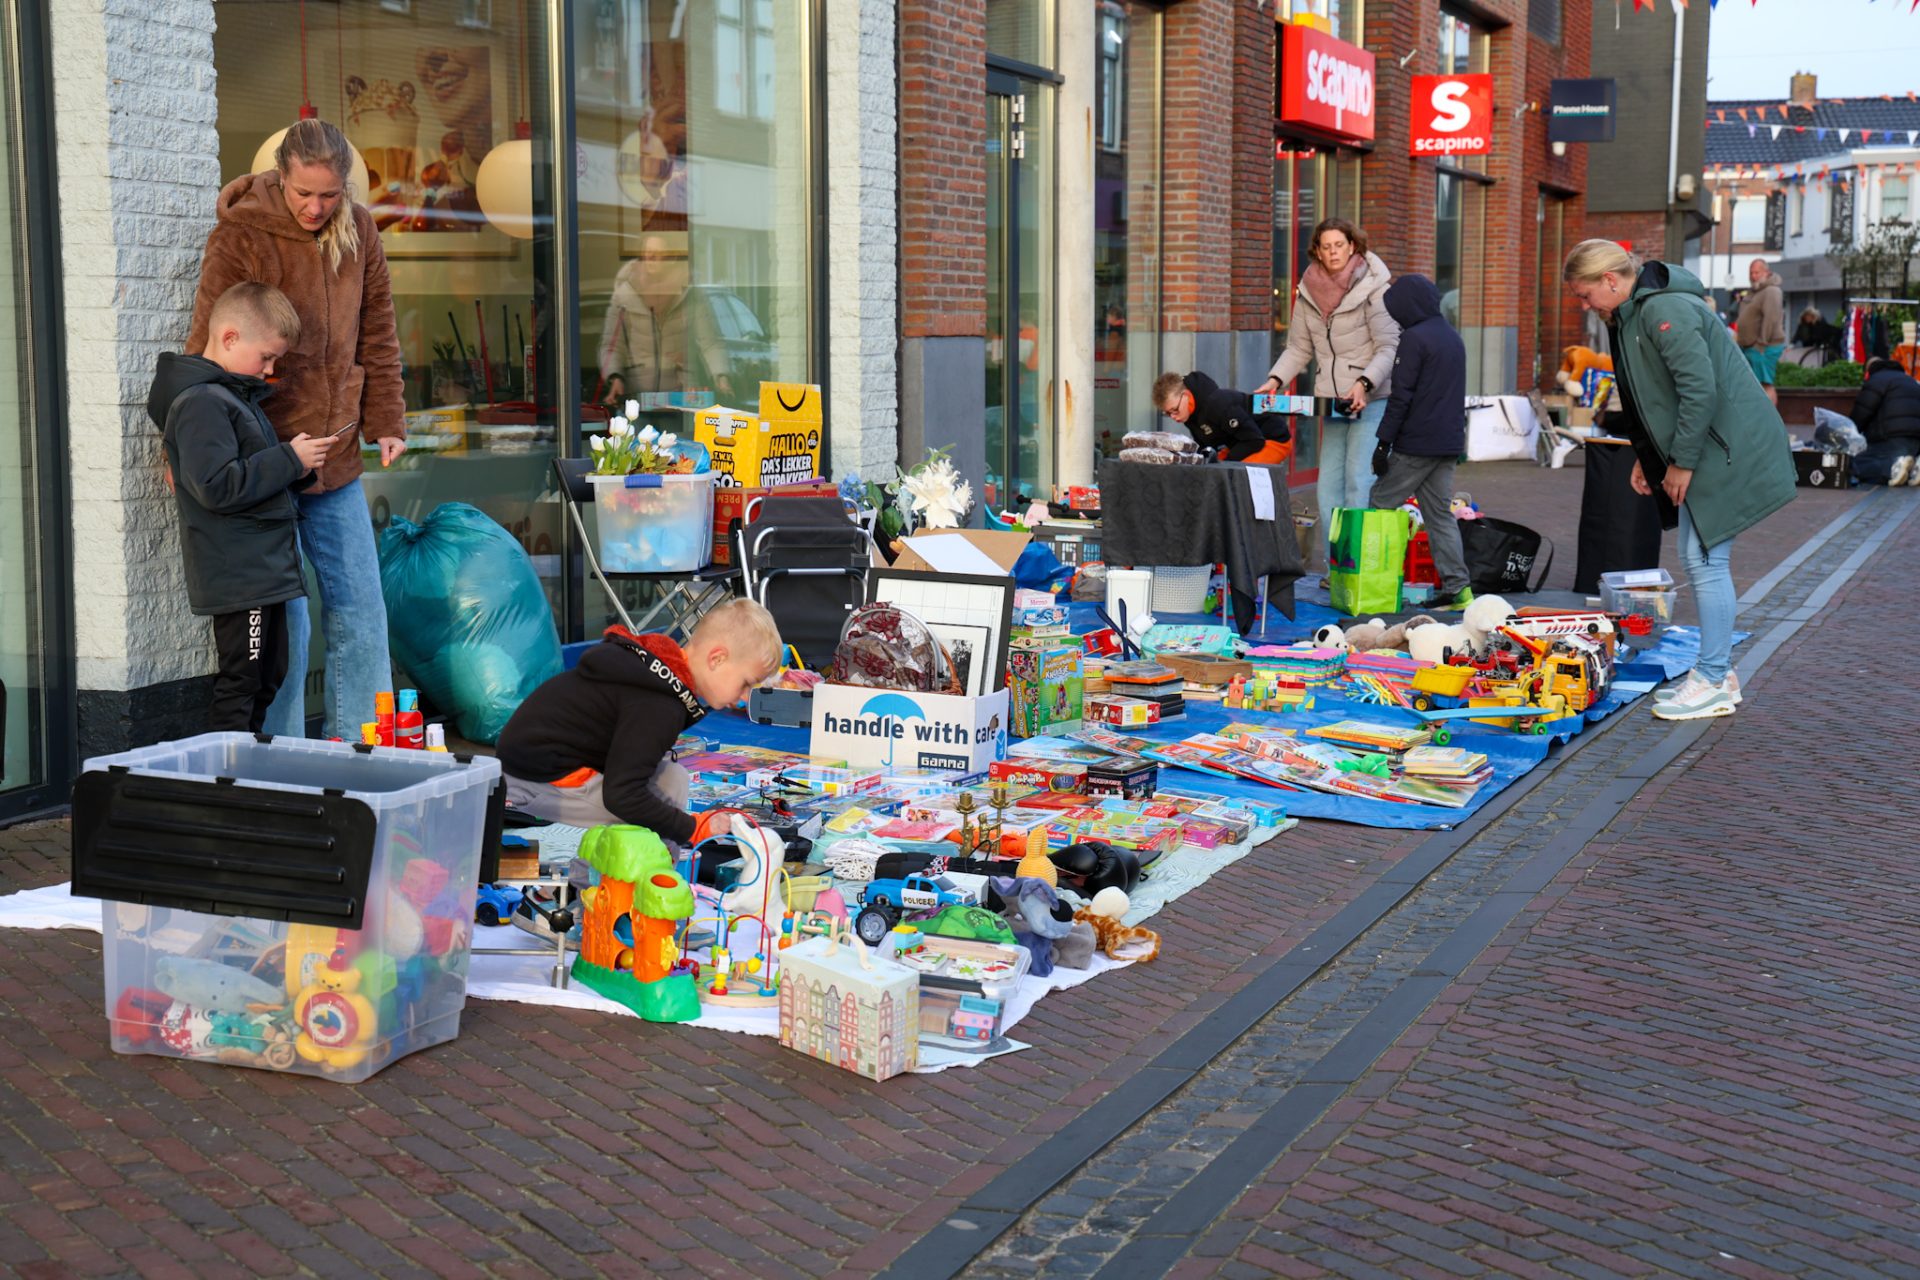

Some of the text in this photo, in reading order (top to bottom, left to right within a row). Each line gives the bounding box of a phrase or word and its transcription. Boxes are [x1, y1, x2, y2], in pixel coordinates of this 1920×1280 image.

[1307, 49, 1372, 130] scapino
[1430, 81, 1471, 132] S
[1415, 137, 1484, 155] scapino
[769, 433, 806, 457] HALLO
[781, 455, 812, 473] LEKKER
[716, 494, 741, 504] PREM
[249, 607, 261, 660] ISSER
[649, 659, 684, 693] BOYS
[824, 712, 905, 739] handle
[914, 721, 969, 745] with
[903, 896, 927, 905] POLICE
